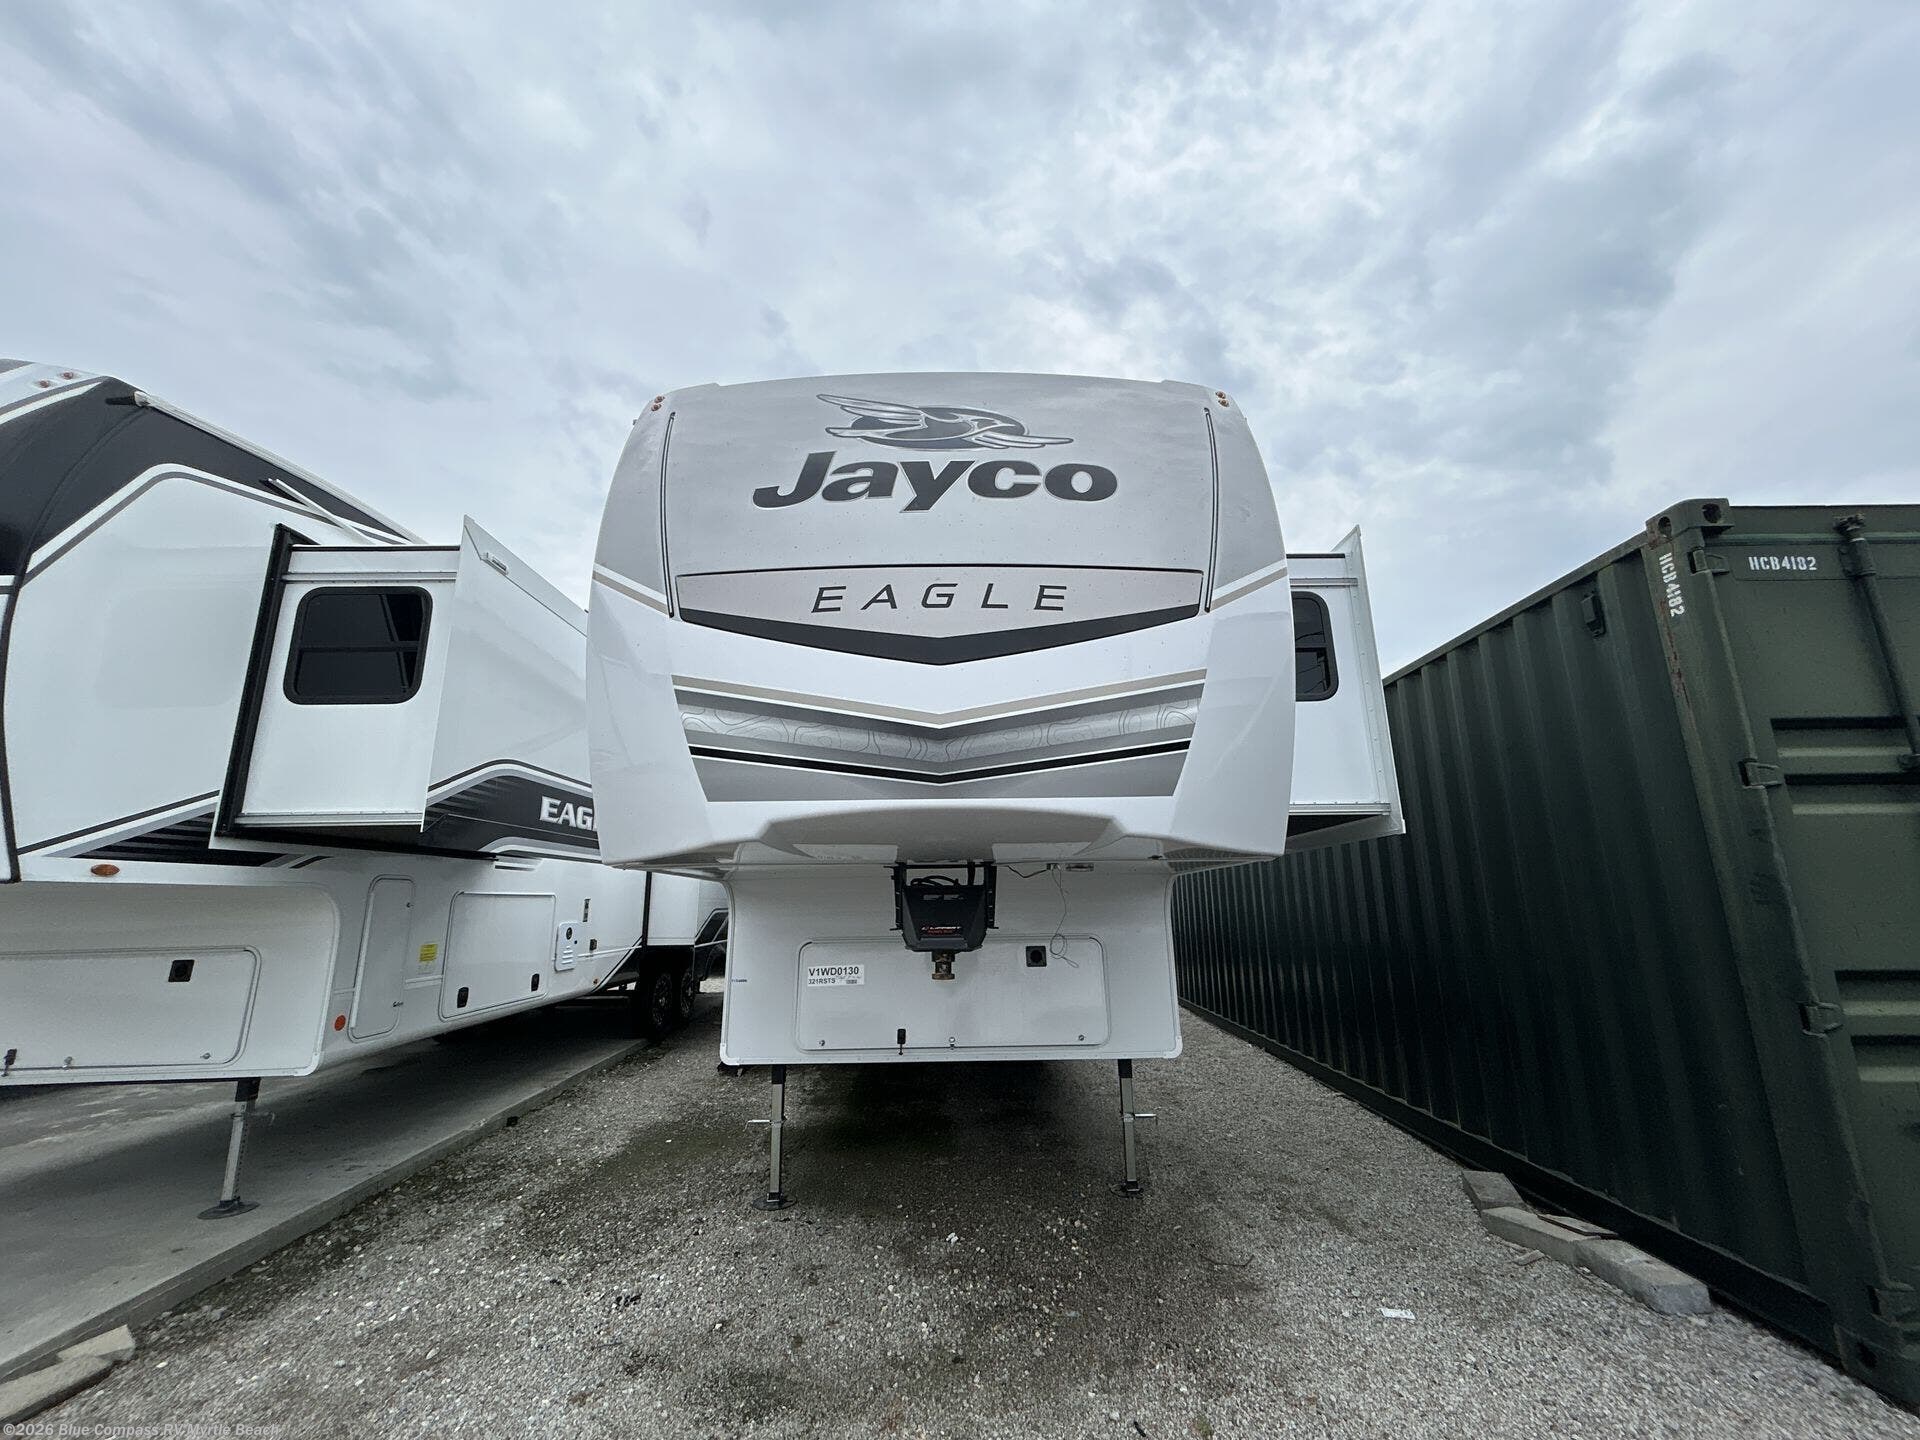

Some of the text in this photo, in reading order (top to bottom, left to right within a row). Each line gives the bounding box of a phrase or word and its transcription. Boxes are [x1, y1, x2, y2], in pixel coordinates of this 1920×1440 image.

[752, 451, 1118, 513] Jayco
[811, 583, 1067, 613] EAGLE
[808, 966, 860, 977] V1WD0130
